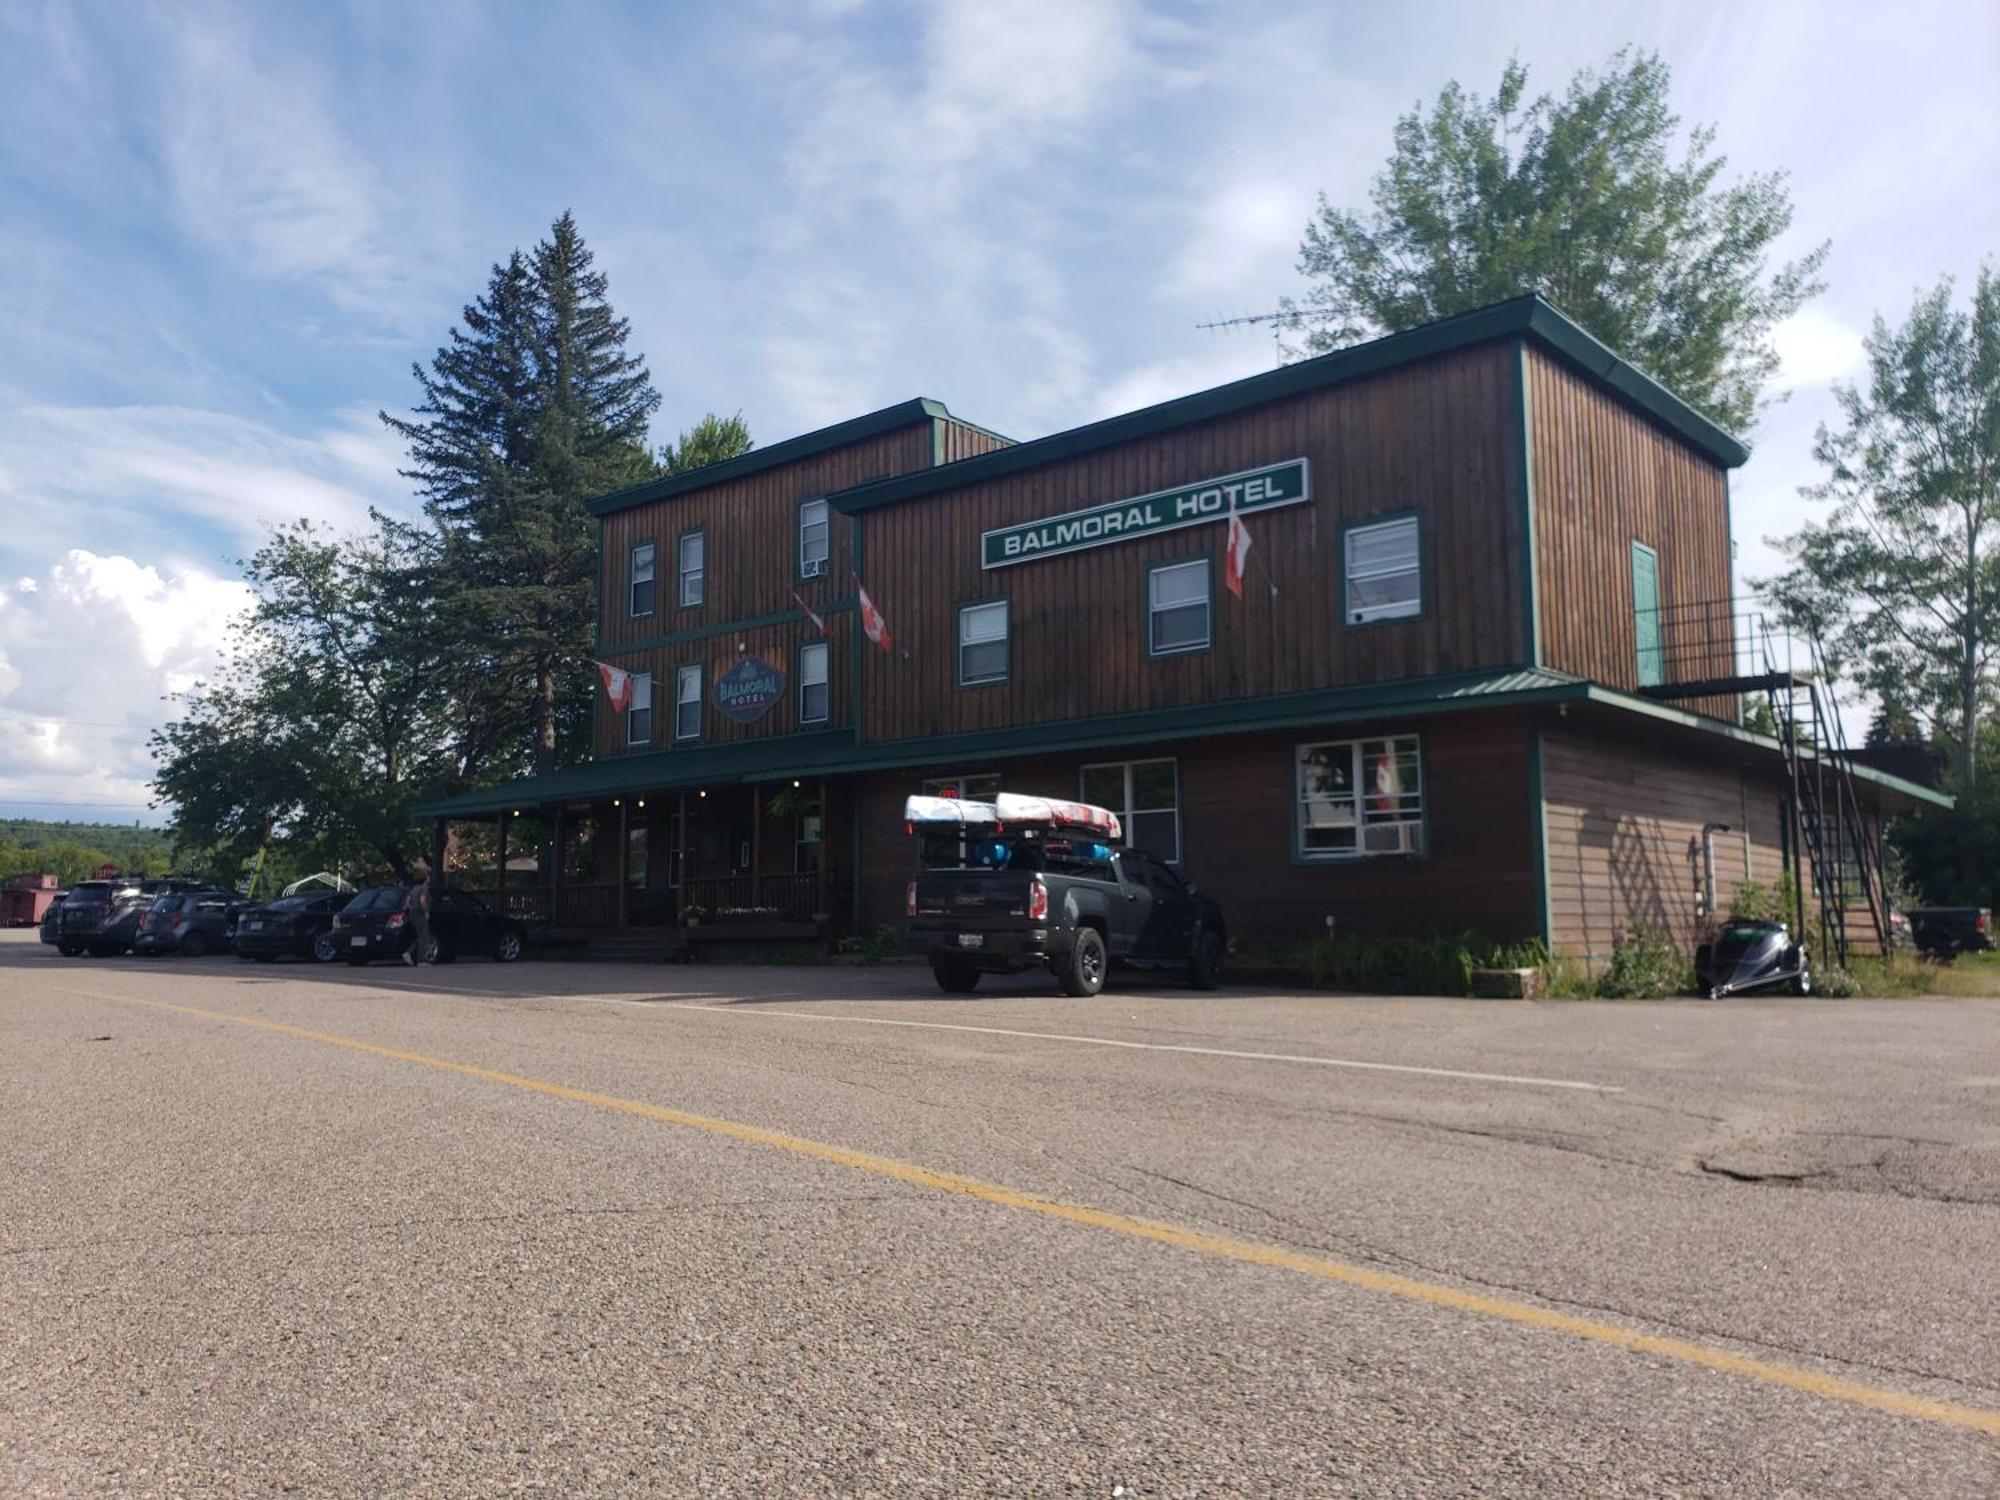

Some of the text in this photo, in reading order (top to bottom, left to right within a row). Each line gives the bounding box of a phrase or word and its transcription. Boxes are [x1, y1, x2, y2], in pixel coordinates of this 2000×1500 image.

[1004, 477, 1283, 556] BALMORAL HOTEL
[731, 693, 765, 705] HOTEL
